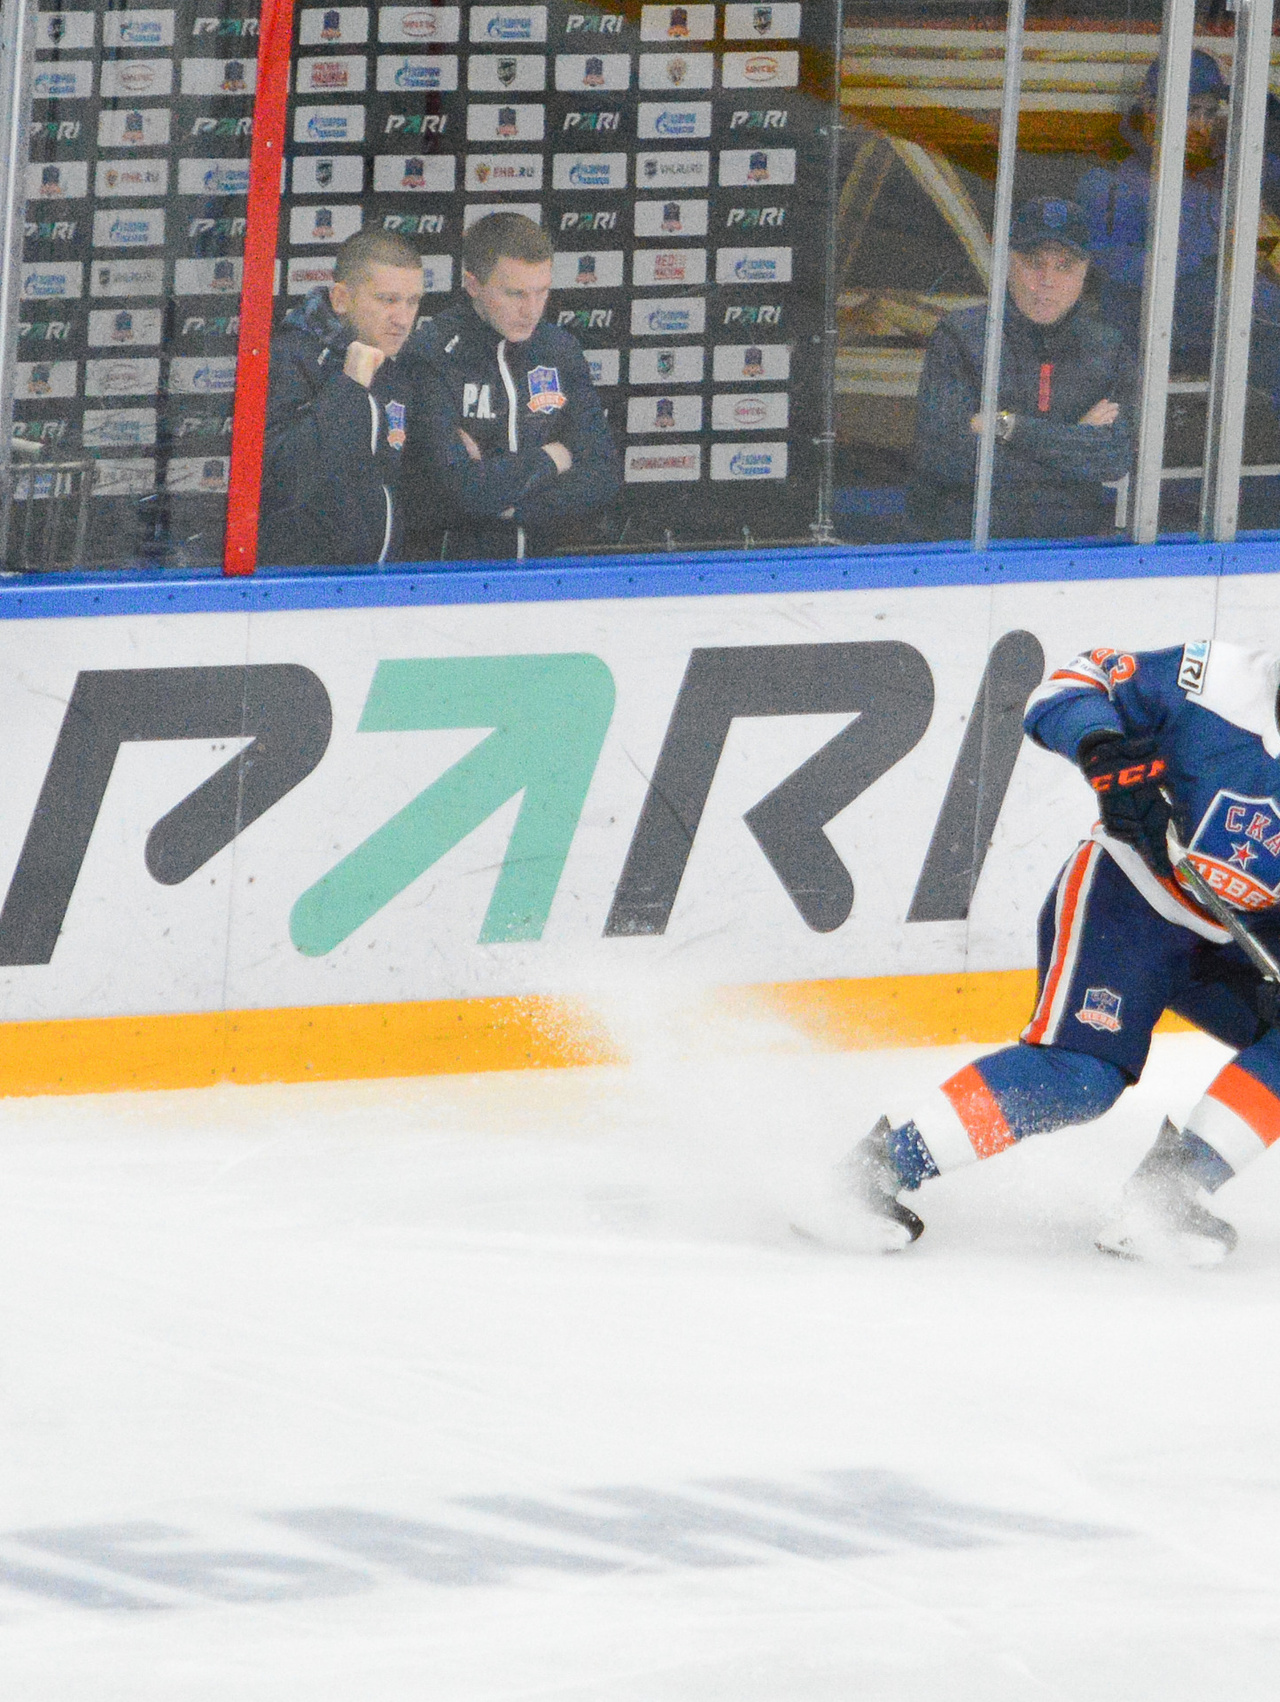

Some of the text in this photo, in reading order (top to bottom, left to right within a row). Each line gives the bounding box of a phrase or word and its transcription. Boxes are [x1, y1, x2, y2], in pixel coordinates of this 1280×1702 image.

[385, 114, 448, 133] PARI
[563, 112, 620, 130] PARI
[730, 110, 788, 129] PARI
[560, 212, 617, 230] PARI
[727, 206, 785, 227] PARI
[557, 309, 613, 327] PARI
[723, 305, 781, 324] PARI
[462, 383, 497, 419] P.A.
[0, 629, 1045, 965] PARI
